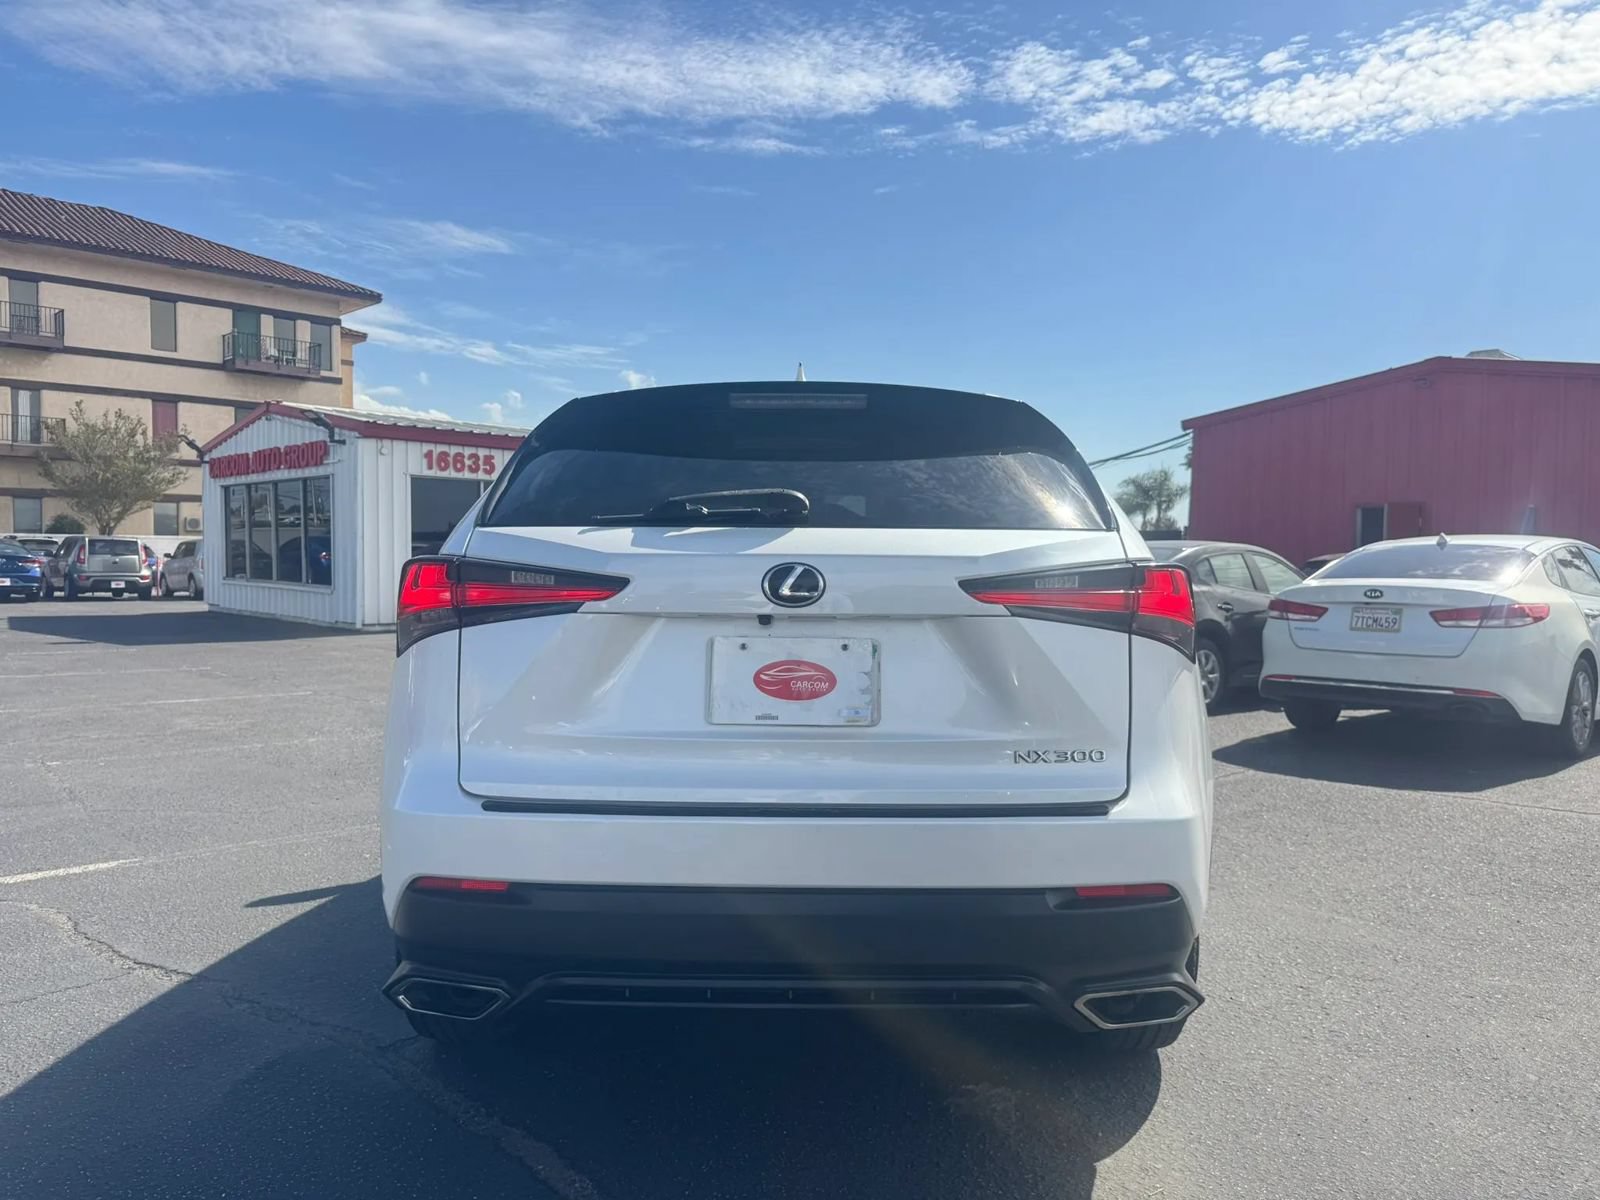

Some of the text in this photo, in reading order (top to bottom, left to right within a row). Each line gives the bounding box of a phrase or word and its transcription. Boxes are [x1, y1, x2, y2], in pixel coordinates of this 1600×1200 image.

[209, 440, 328, 478] CARCOM AUTO GROUP
[424, 449, 495, 475] 16635
[1354, 615, 1398, 628] 7TCM459
[790, 681, 829, 689] CARCOM
